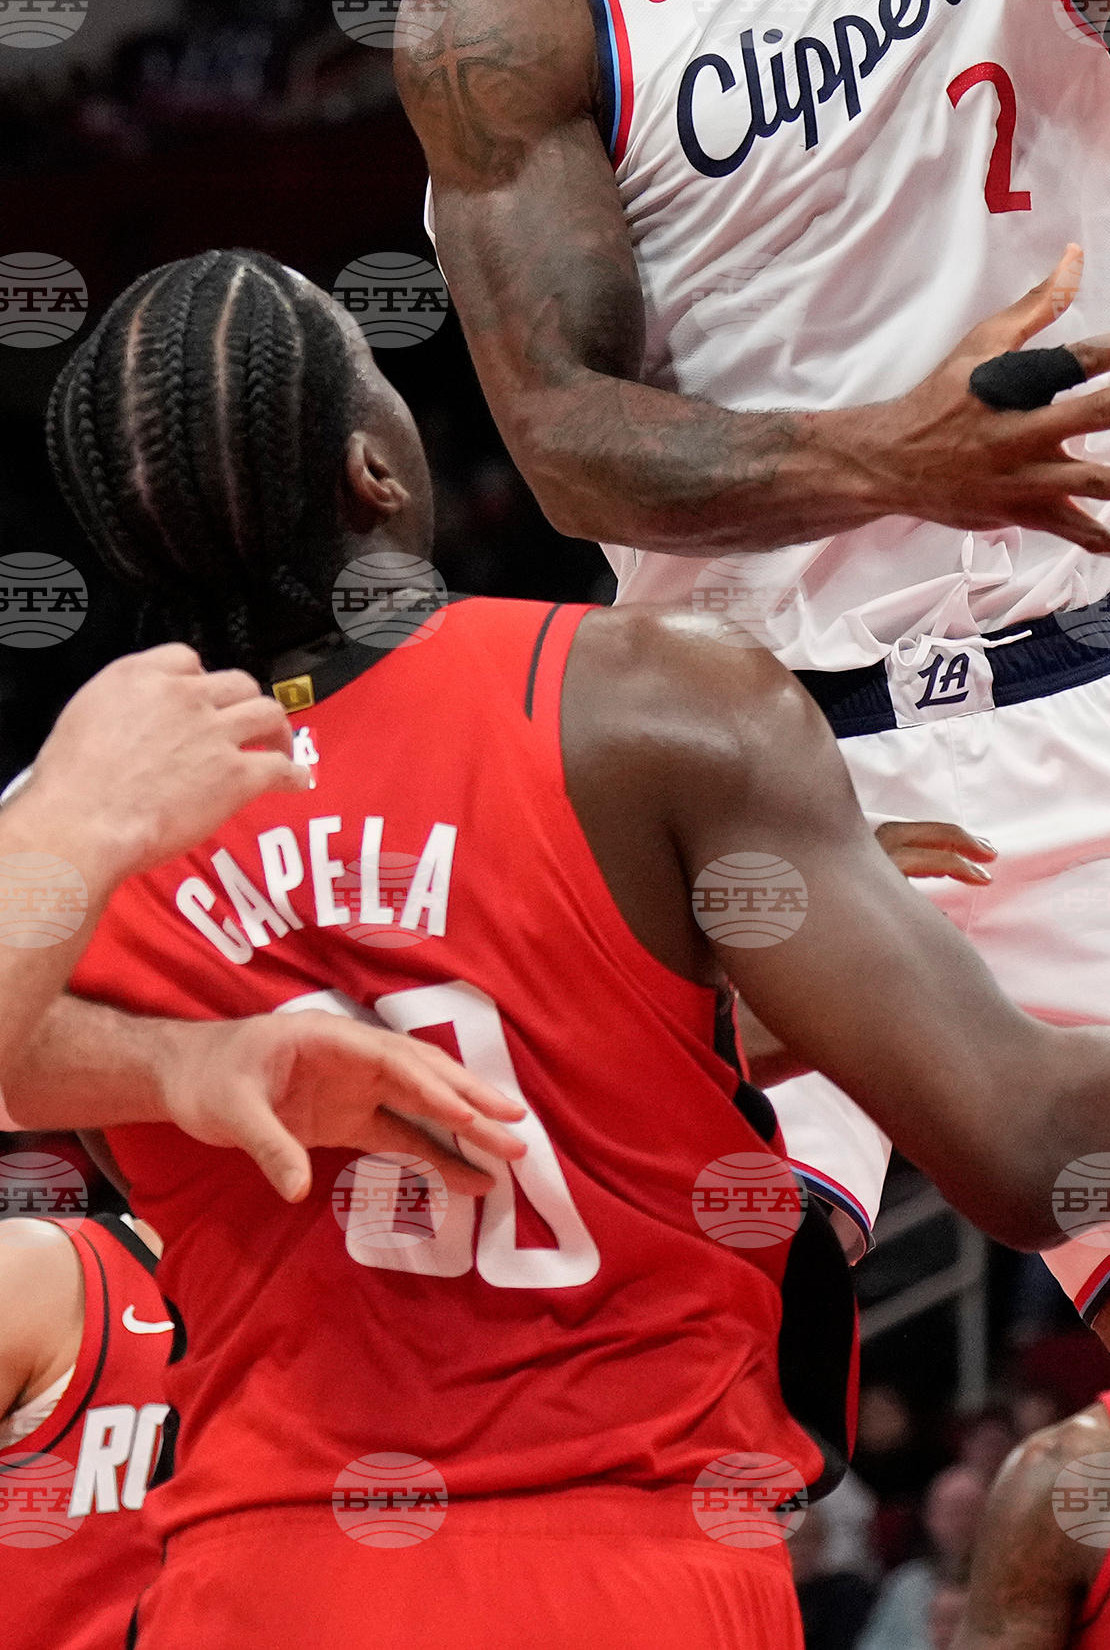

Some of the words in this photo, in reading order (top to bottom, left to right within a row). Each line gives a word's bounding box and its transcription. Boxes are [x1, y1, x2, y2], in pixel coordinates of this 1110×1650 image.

[946, 61, 1032, 214] 2
[915, 652, 970, 710] LA
[176, 815, 457, 965] CAPELA
